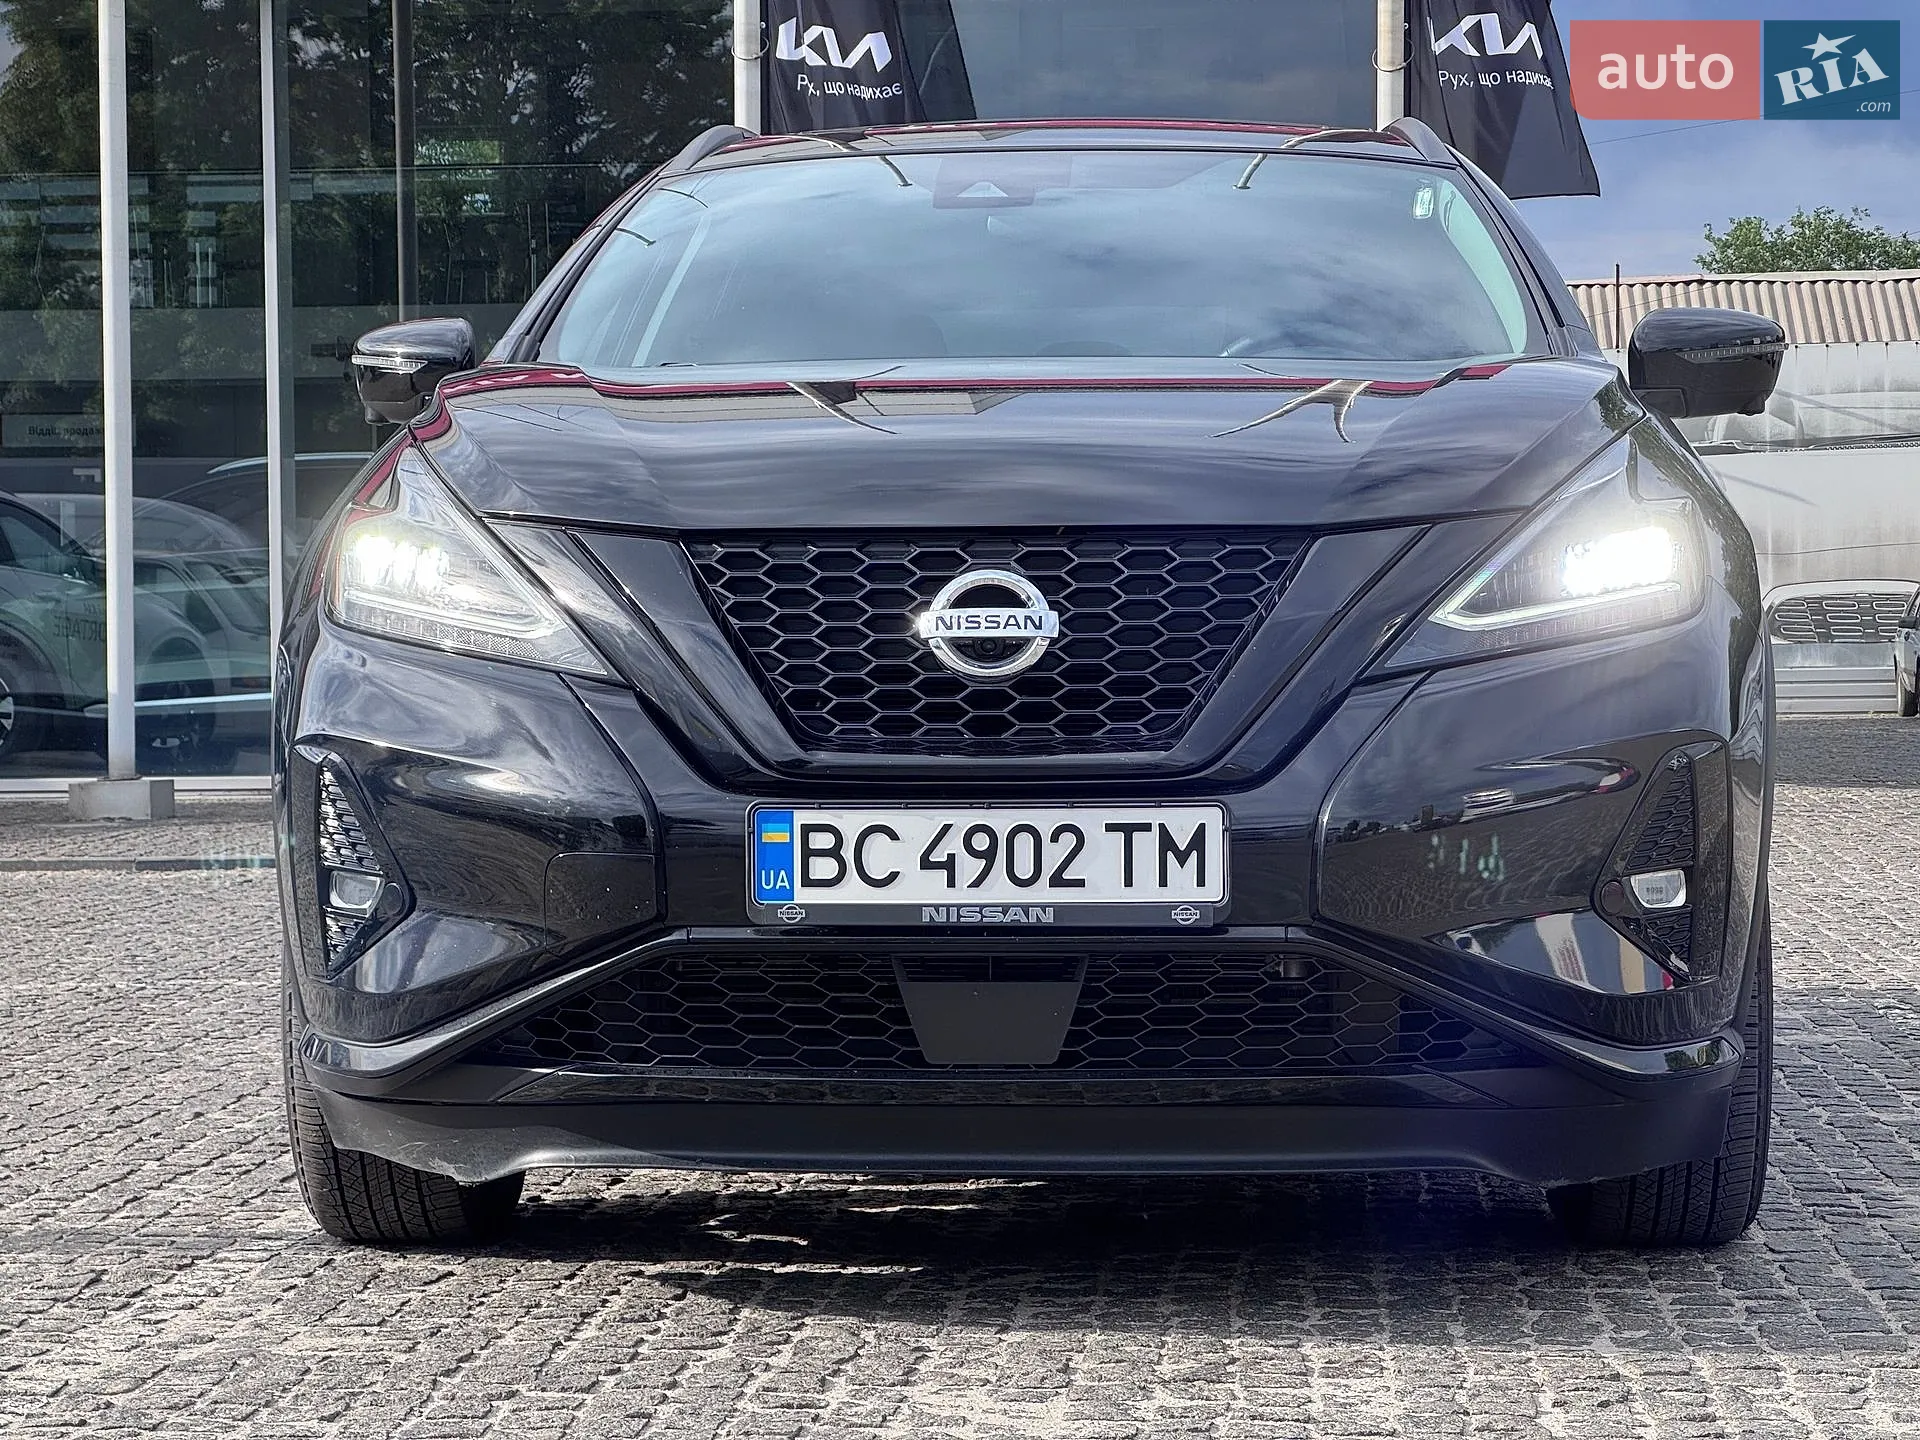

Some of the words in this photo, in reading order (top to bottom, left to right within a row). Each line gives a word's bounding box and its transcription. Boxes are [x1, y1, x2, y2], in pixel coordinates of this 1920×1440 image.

[1438, 70, 1475, 90] Рух,
[1478, 71, 1501, 88] що
[823, 81, 845, 97] що
[846, 82, 903, 101] надихає
[935, 614, 1043, 631] NISSAN
[800, 823, 902, 889] BC
[919, 822, 1087, 889] 4902
[1104, 822, 1207, 889] TM
[761, 869, 790, 890] UA
[922, 906, 1054, 924] NISSAN
